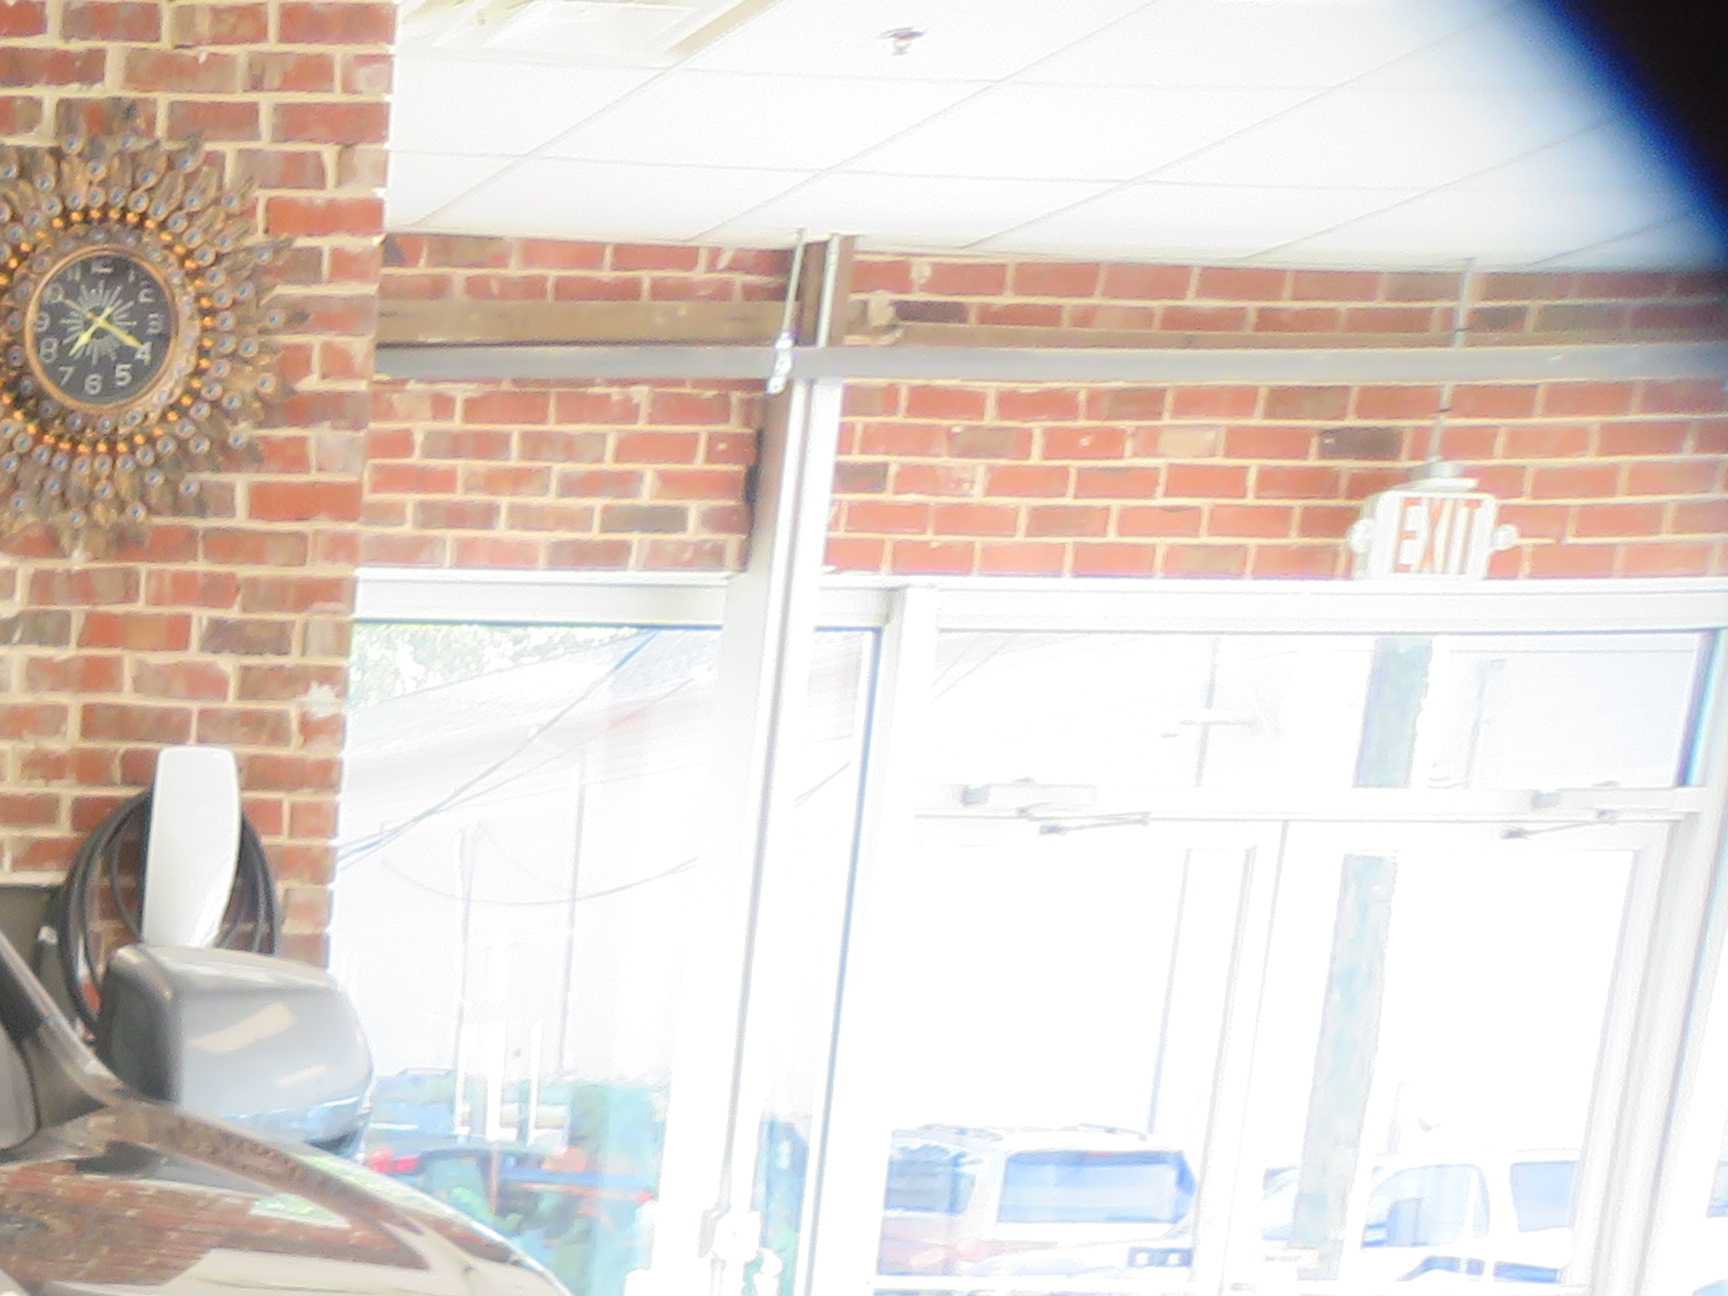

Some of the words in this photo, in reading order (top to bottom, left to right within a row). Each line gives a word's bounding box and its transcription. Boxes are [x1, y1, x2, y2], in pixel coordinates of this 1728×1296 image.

[146, 313, 164, 335] 3
[39, 337, 58, 364] 8
[134, 341, 153, 366] 4
[58, 366, 75, 387] 7
[84, 373, 103, 395] 6
[115, 363, 133, 386] 5
[1394, 497, 1482, 575] EXIT
